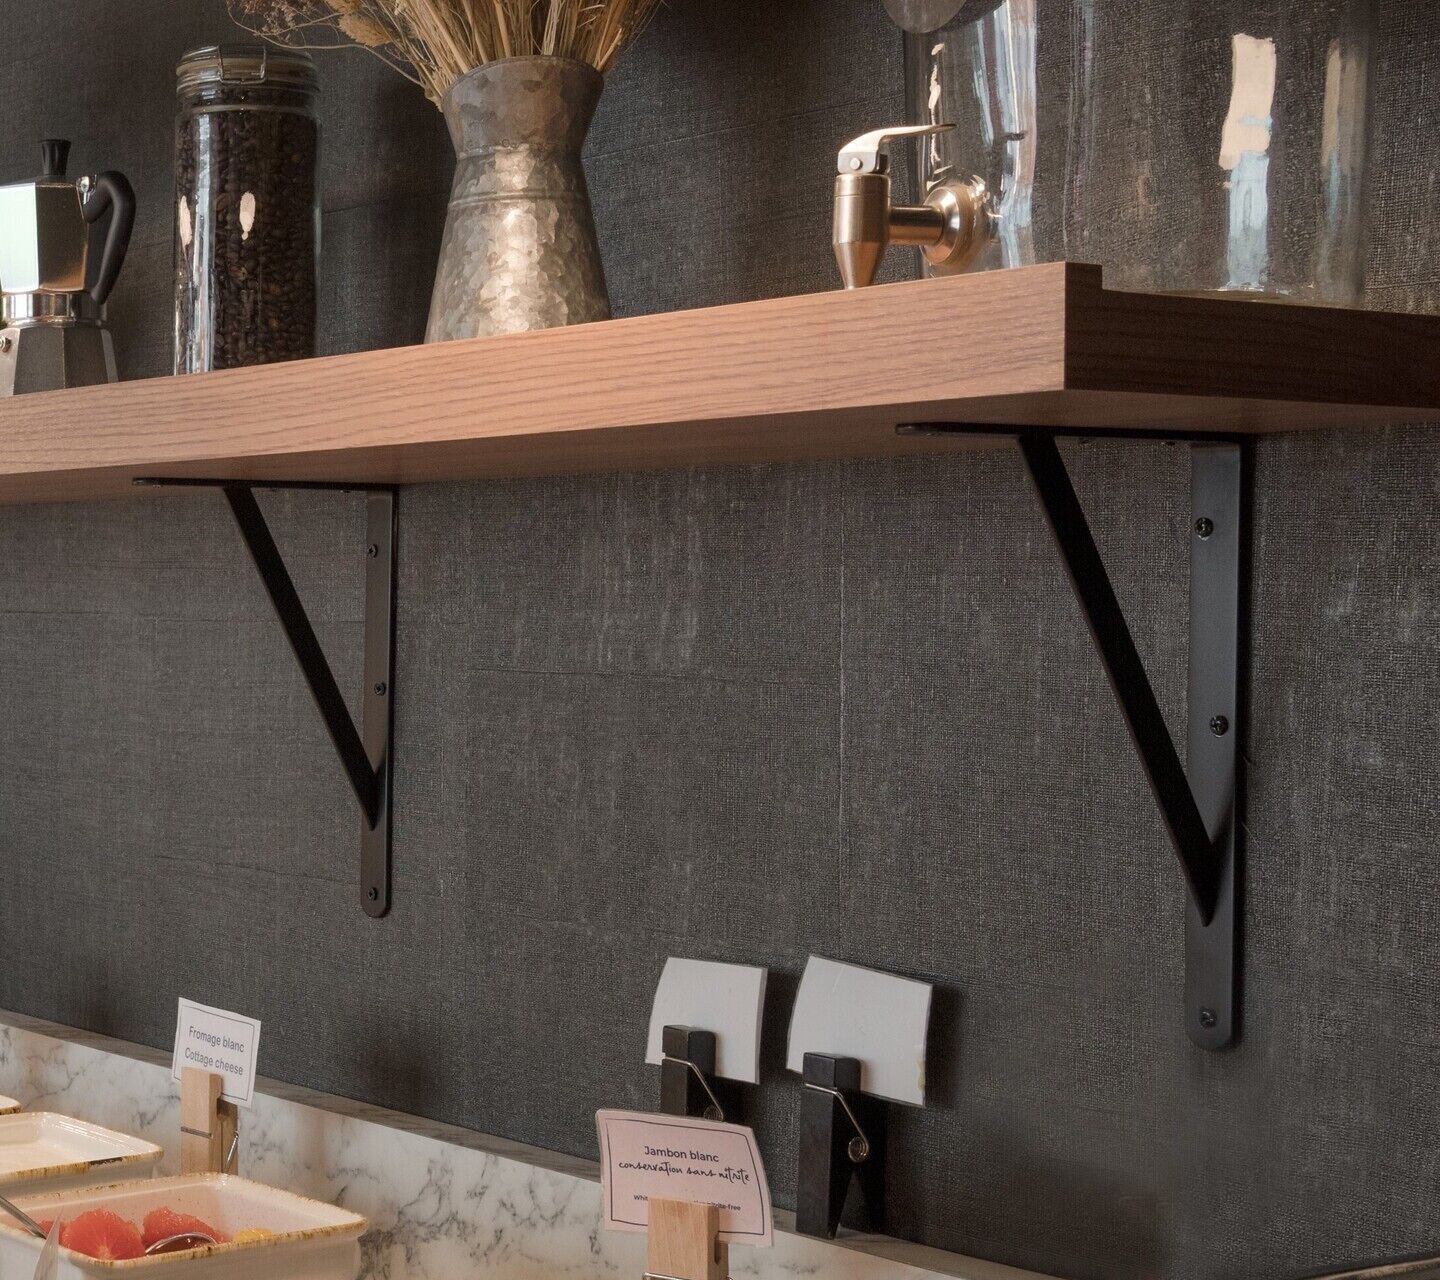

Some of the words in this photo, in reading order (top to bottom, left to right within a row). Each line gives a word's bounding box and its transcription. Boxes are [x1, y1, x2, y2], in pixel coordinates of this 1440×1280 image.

[189, 1026, 221, 1047] Fromage
[222, 1036, 244, 1053] blanc
[184, 1047, 214, 1067] Cottage
[215, 1057, 244, 1076] cheese
[644, 1145, 687, 1159] Jambon
[689, 1150, 719, 1163] blanc
[618, 1161, 683, 1176] conservation
[687, 1167, 717, 1178] sans
[718, 1166, 751, 1185] nitrite
